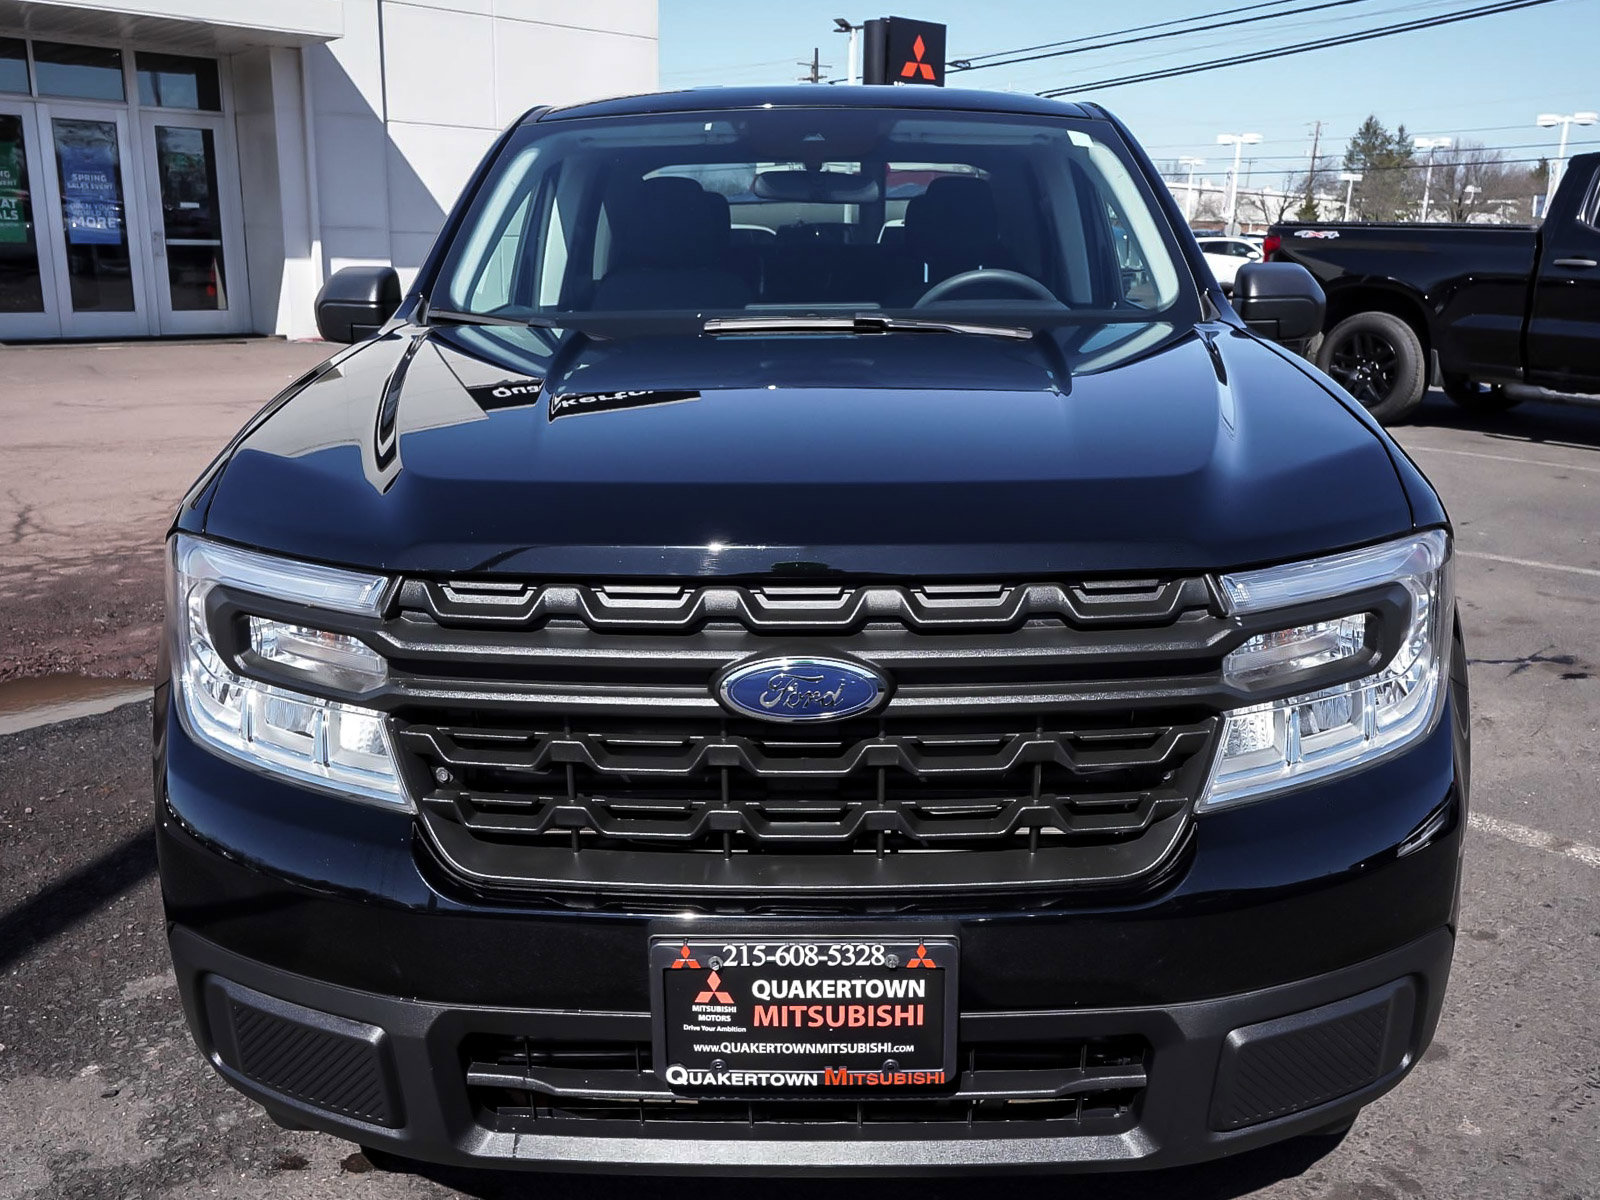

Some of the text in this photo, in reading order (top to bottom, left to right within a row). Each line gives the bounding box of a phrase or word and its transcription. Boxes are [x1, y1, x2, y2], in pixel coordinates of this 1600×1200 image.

[71, 173, 108, 182] SPRING
[71, 216, 117, 229] MORE
[759, 673, 846, 708] Ford
[722, 944, 885, 967] 215-608-5328
[751, 979, 926, 1000] QUAKERTOWN
[692, 1005, 737, 1013] MITSUBISHI
[698, 1014, 732, 1022] MOTORS
[753, 1004, 925, 1027] MITSUBISHI
[665, 1066, 946, 1086] QUAKERTOWN MITSUBISHI
